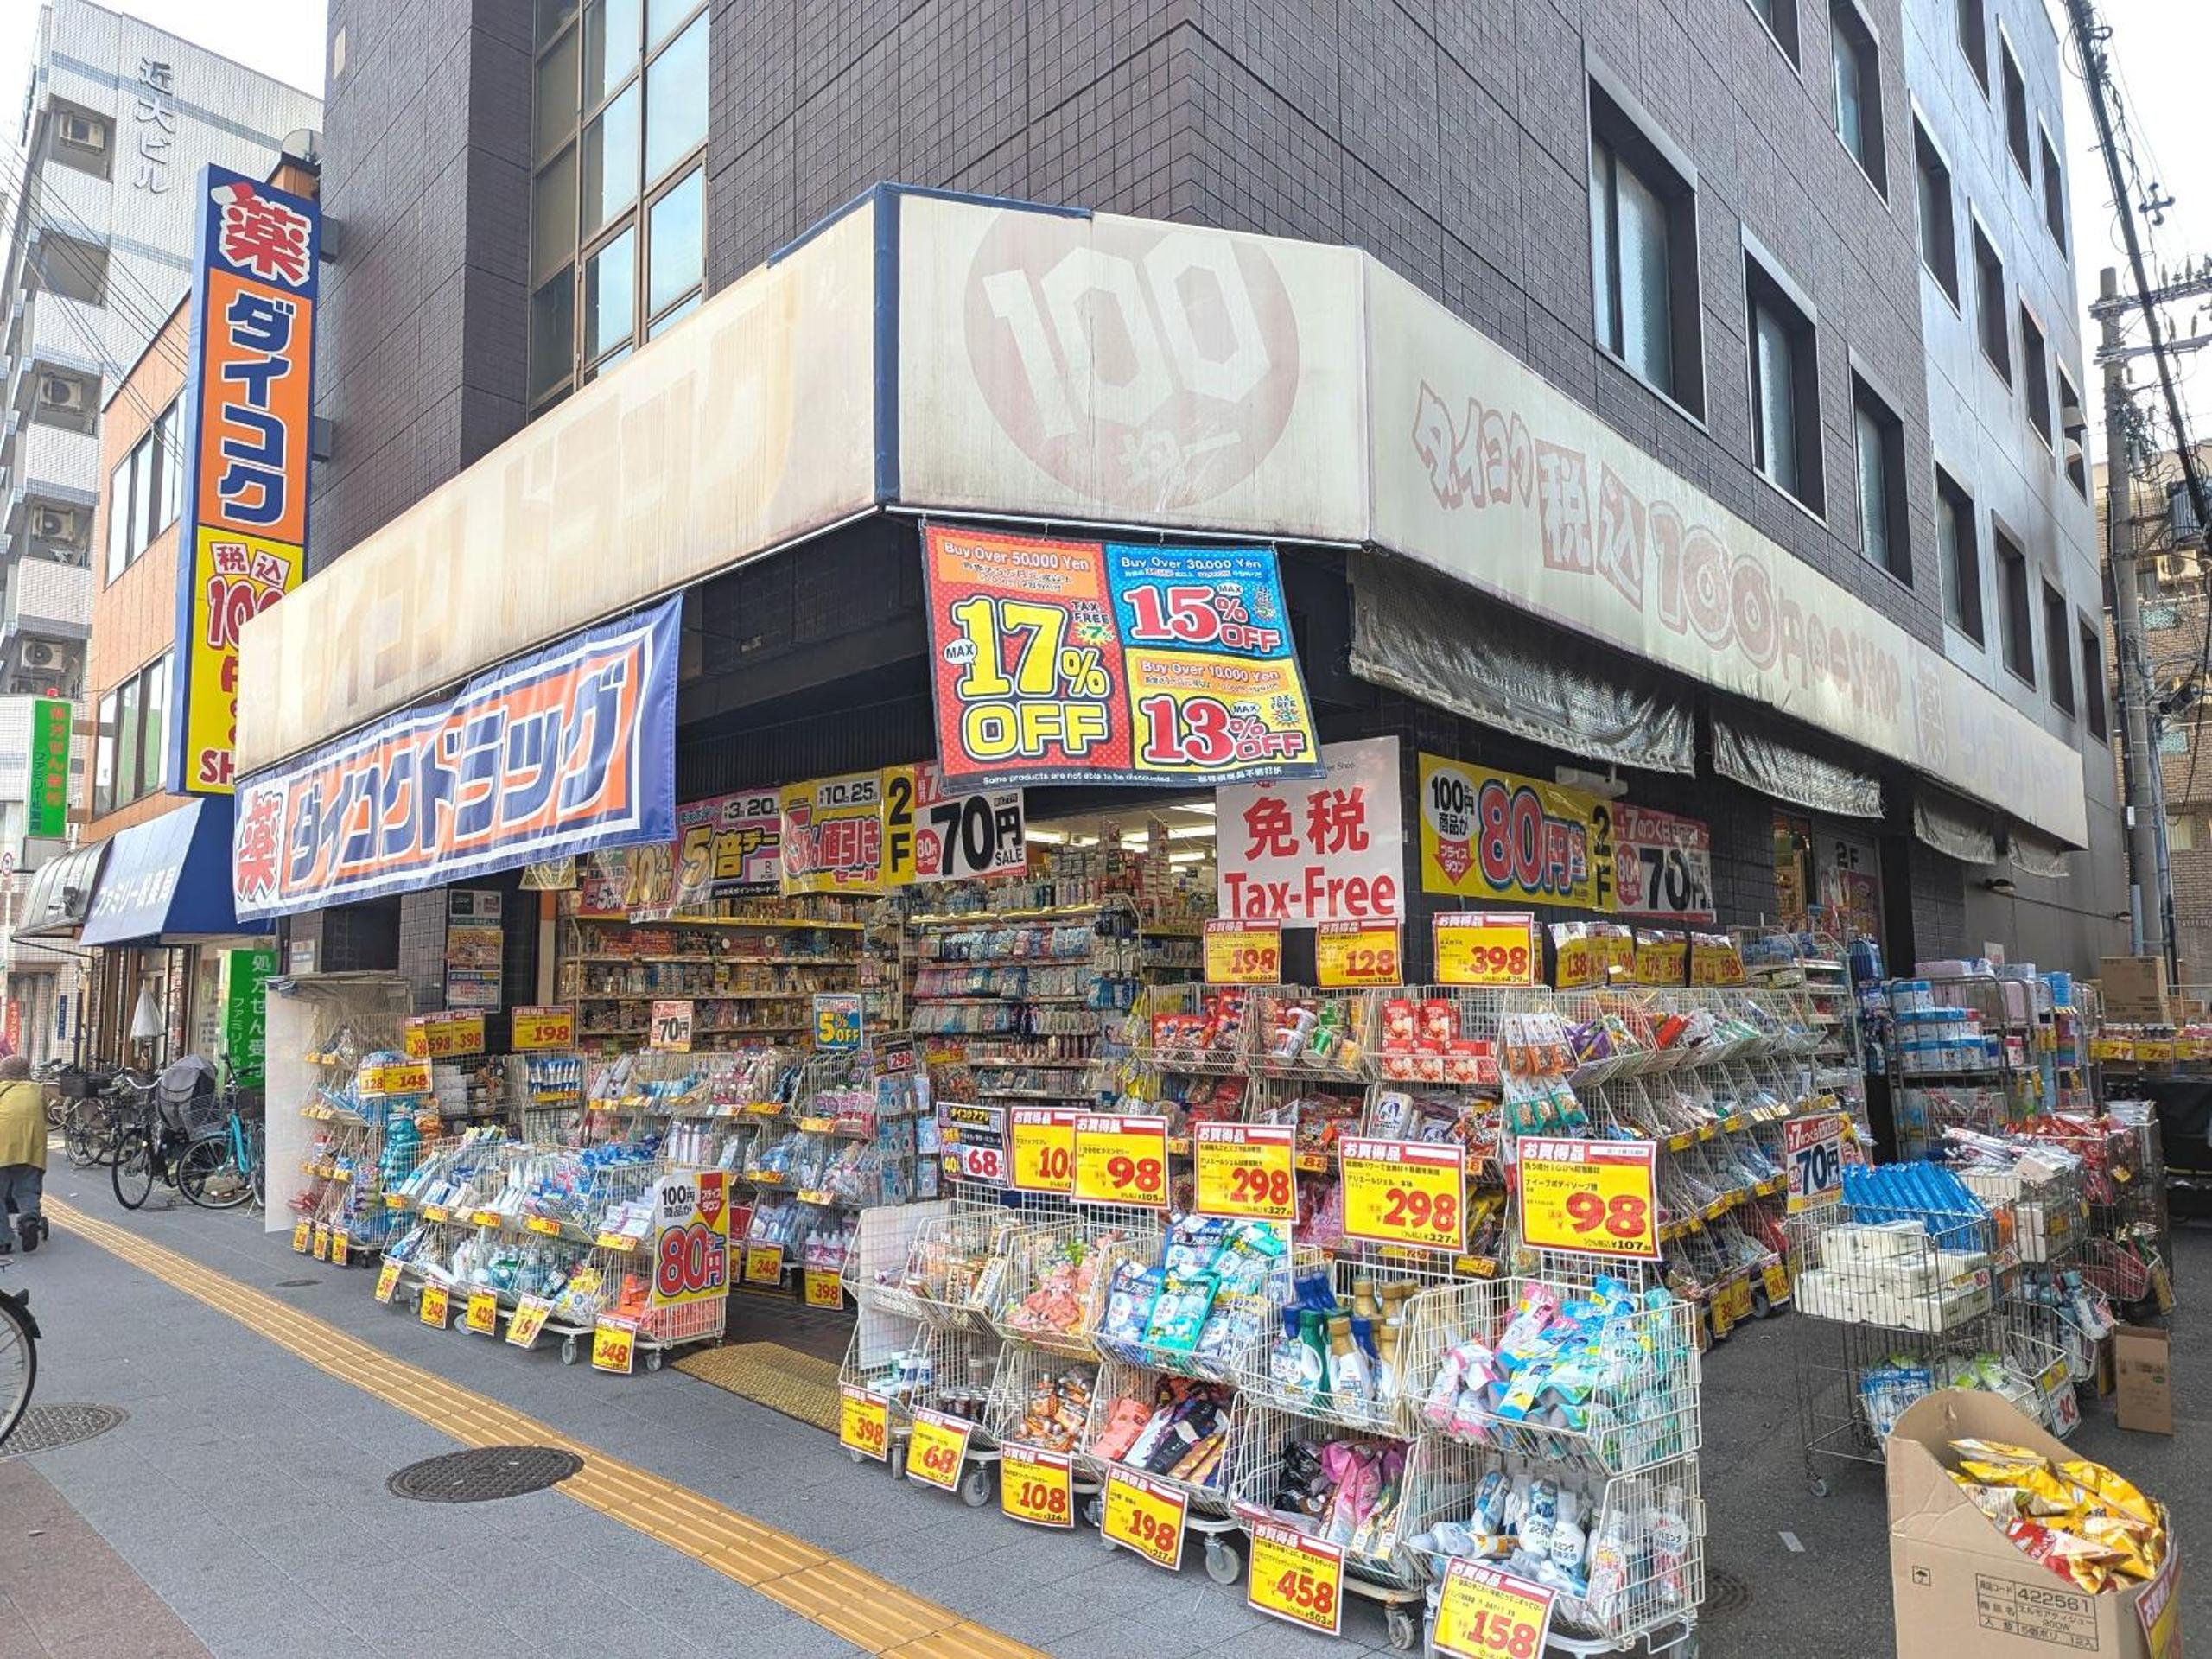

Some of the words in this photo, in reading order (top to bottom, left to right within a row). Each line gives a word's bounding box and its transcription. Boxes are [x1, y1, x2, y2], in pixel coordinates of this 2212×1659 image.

[134, 56, 176, 195] 近大ビル
[213, 184, 311, 286] 薬
[218, 289, 298, 527] ダイコク
[218, 543, 282, 587] 税込
[944, 542, 969, 558] Buy
[974, 548, 1007, 563] Over
[1062, 557, 1090, 570] Yen
[1122, 557, 1147, 569] Buy
[1153, 558, 1181, 569] Over
[1237, 559, 1262, 569] Yen
[1218, 584, 1242, 594] MAX
[207, 575, 285, 651] 10
[946, 645, 975, 659] MAX
[1219, 625, 1281, 651] OFF
[1141, 662, 1167, 674] Buy
[1172, 664, 1204, 676] Over
[1253, 670, 1280, 682] Yen
[1234, 705, 1258, 715] MAX
[965, 702, 1107, 759] OFF
[1236, 733, 1306, 760] OFF
[292, 658, 628, 887] ダイコクドラッグ
[983, 775, 1007, 785] Some
[930, 794, 1023, 877] 70円
[1243, 787, 1370, 861] 免税
[237, 787, 284, 903] 薬
[995, 847, 1024, 866] SALE
[832, 867, 879, 884] セール
[1224, 867, 1396, 919] Tax-Free
[1231, 949, 1277, 975] 198
[1346, 950, 1395, 977] 128
[1471, 946, 1528, 976] 398
[460, 1032, 482, 1048] 398
[533, 1026, 570, 1042] 198
[836, 1028, 860, 1043] OFF
[399, 1074, 429, 1088] 148
[968, 1147, 998, 1178] 68
[1343, 1142, 1402, 1162] お買得品
[1522, 1141, 1585, 1163] お買得品
[1107, 1156, 1162, 1192] 98
[1230, 1166, 1291, 1206] 298
[1382, 1187, 1457, 1233] 298
[1565, 1191, 1648, 1239] 98
[756, 1260, 777, 1276] 248
[815, 1282, 838, 1300] 398
[475, 1306, 494, 1325] 428
[598, 1339, 628, 1364] 348
[856, 1416, 884, 1446] 398
[922, 1444, 957, 1475] 68
[1019, 1481, 1066, 1514] 108
[1128, 1508, 1177, 1553] 198
[1275, 1569, 1334, 1615] 458
[2017, 1587, 2089, 1613] 422561
[1466, 1609, 1537, 1659] 158
